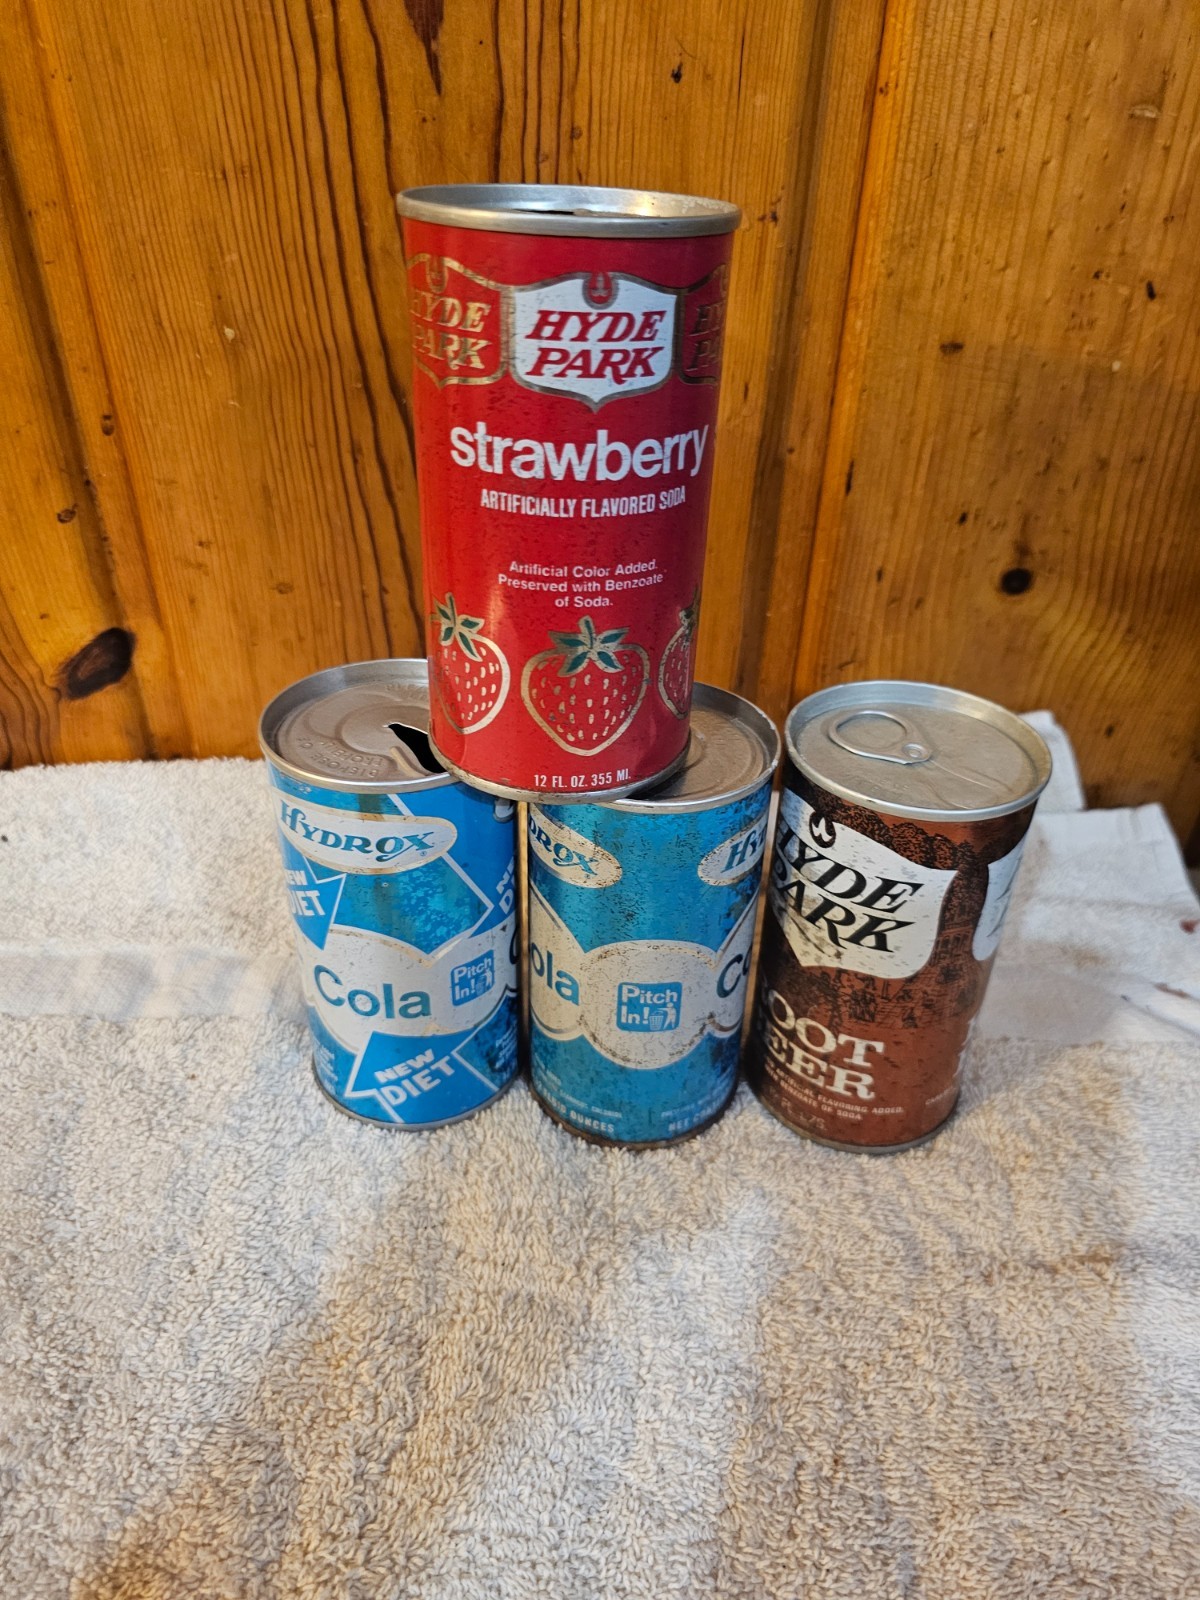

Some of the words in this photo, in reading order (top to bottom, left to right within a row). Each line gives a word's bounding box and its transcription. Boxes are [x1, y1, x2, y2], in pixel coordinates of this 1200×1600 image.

[525, 310, 667, 343] HYDE
[525, 346, 665, 385] PARK
[450, 421, 709, 481] strawberry
[480, 489, 576, 518] ARTIFICIALLY
[581, 494, 655, 518] FLAVORED
[659, 486, 686, 510] SODA
[498, 573, 568, 593] Preserved
[571, 579, 601, 593] with
[605, 572, 664, 592] Benzoate
[509, 560, 568, 578] Artificial
[572, 565, 611, 579] Color
[614, 559, 659, 576] Added.
[554, 595, 570, 608] of
[573, 595, 614, 608] Soda.
[533, 773, 548, 788] 12
[552, 775, 568, 788] FL.
[570, 774, 588, 788] OZ.
[591, 771, 613, 787] 355
[529, 814, 600, 877] DROX
[453, 957, 493, 984] Pitch
[530, 942, 579, 1007] ola
[313, 964, 432, 1019] Cola
[454, 973, 477, 1001] In!
[620, 984, 678, 1005] Pitch
[620, 1004, 650, 1026] In!
[768, 988, 885, 1068] OOT
[373, 1048, 436, 1084] NEW
[766, 1026, 876, 1101] EER
[380, 1054, 456, 1107] DIET
[569, 1109, 615, 1134] OUNCES
